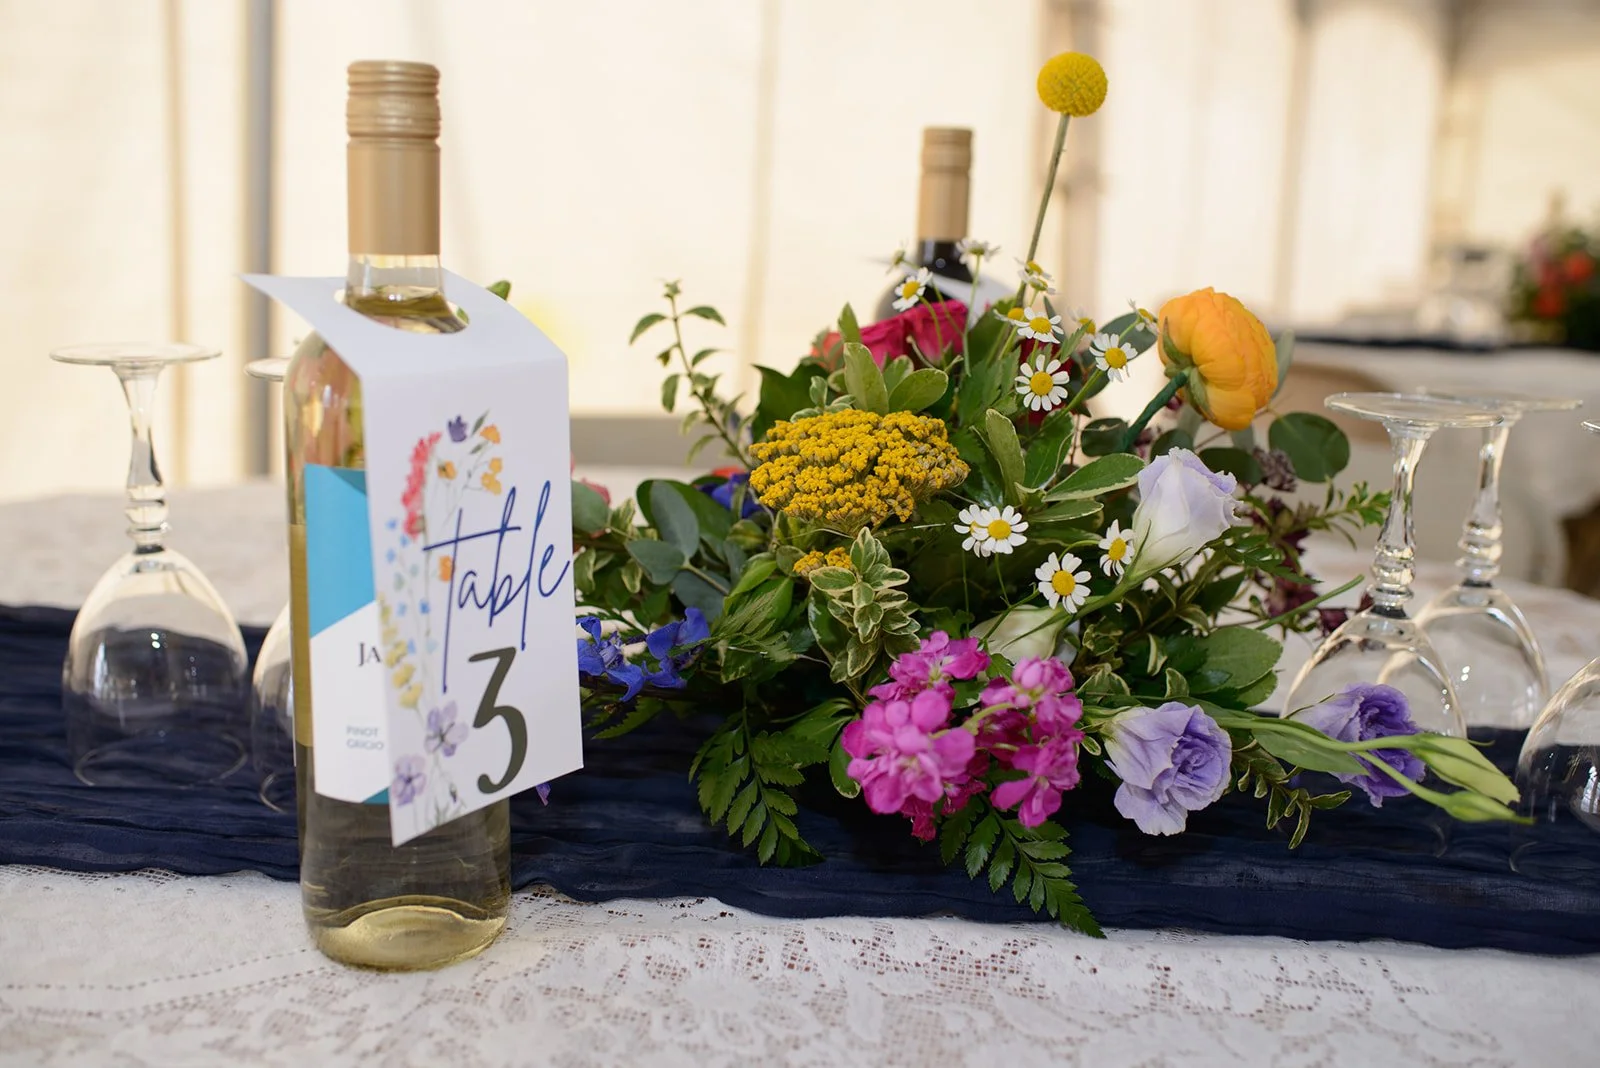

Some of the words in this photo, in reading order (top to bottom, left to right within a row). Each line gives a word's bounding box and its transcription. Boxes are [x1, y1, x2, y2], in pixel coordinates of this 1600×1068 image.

[422, 480, 570, 693] table
[346, 725, 378, 737] PINOT
[346, 738, 385, 751] GRIGIO
[468, 646, 528, 795] 3
